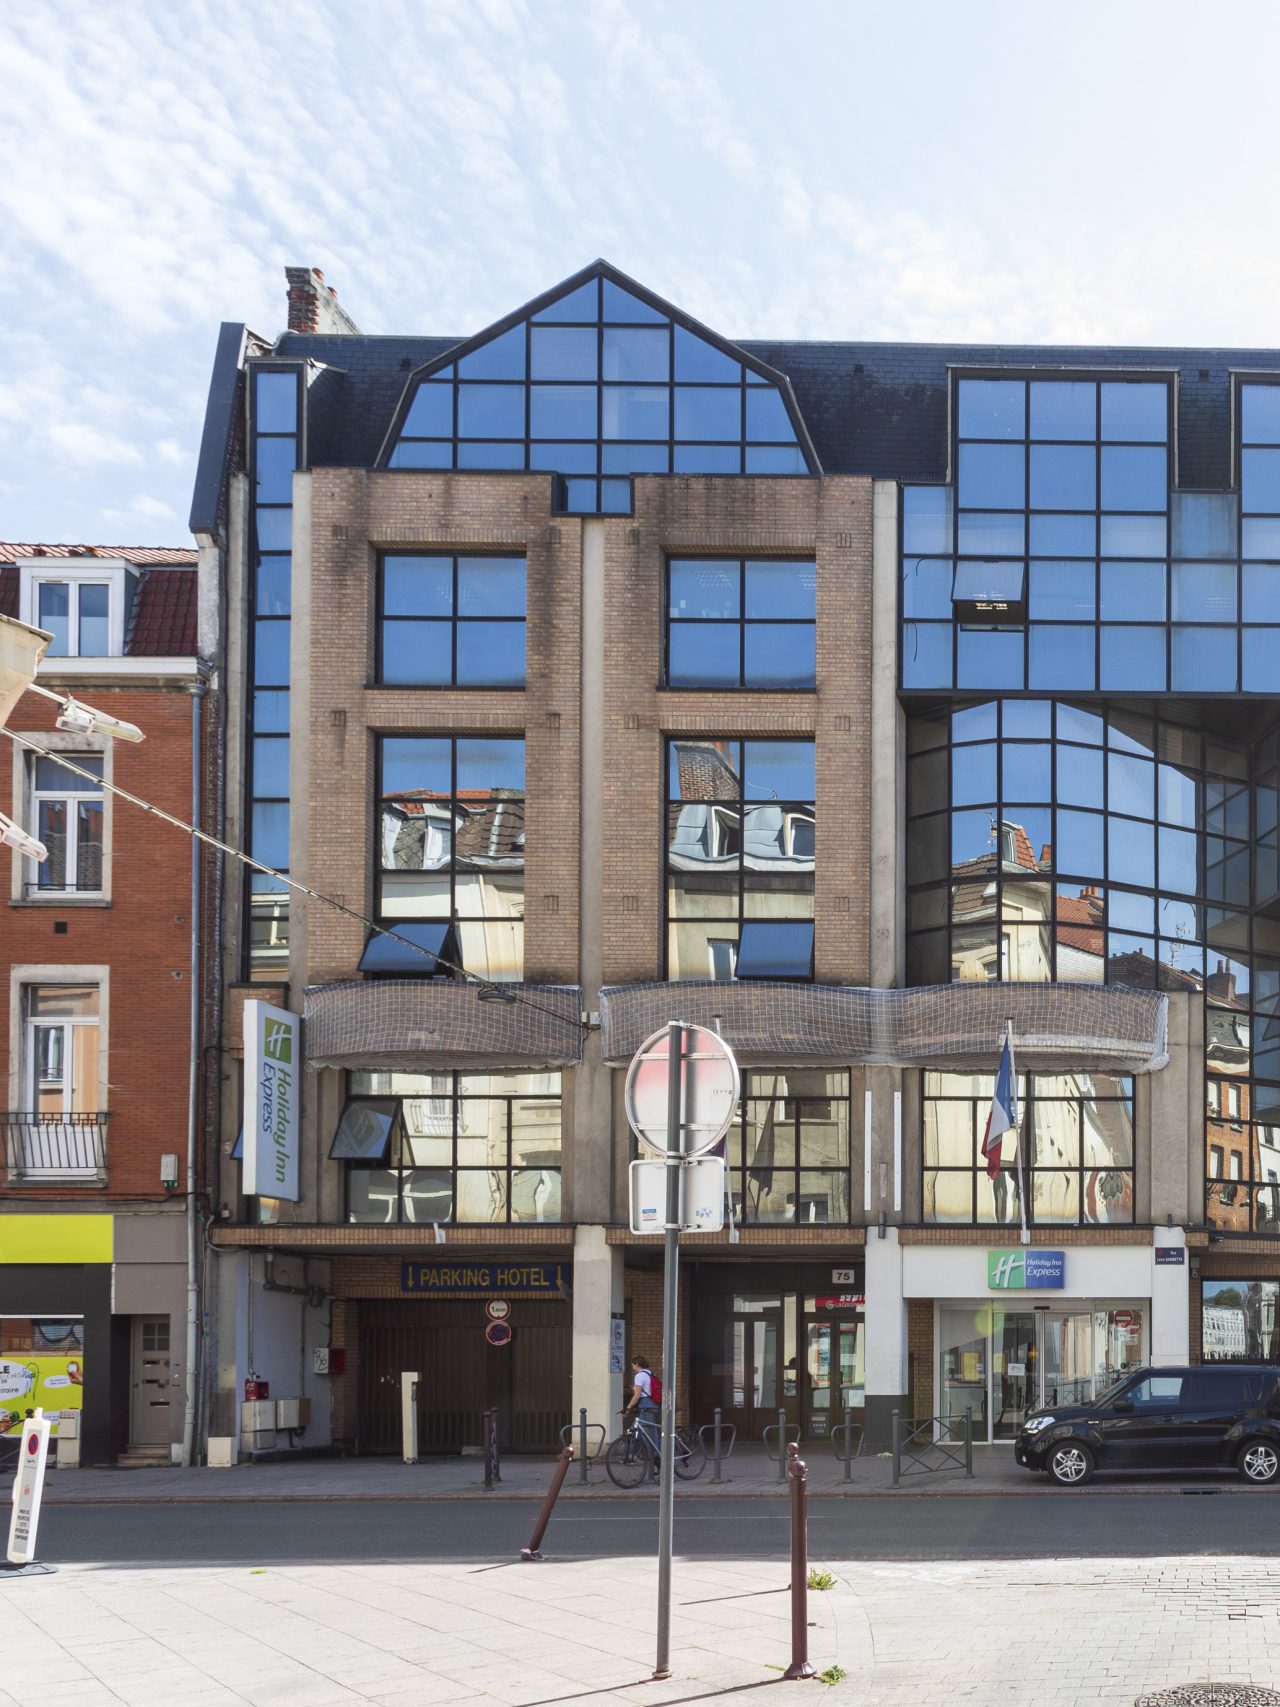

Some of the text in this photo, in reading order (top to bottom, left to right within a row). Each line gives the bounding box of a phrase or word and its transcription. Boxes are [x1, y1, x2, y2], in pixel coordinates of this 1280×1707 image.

[260, 1062, 276, 1134] Express
[273, 1067, 292, 1184] Holiday Inn
[1027, 1258, 1052, 1267] Holiday
[419, 1268, 550, 1286] PARKING HOTEL
[836, 1272, 851, 1281] 75
[1027, 1266, 1061, 1277] Express
